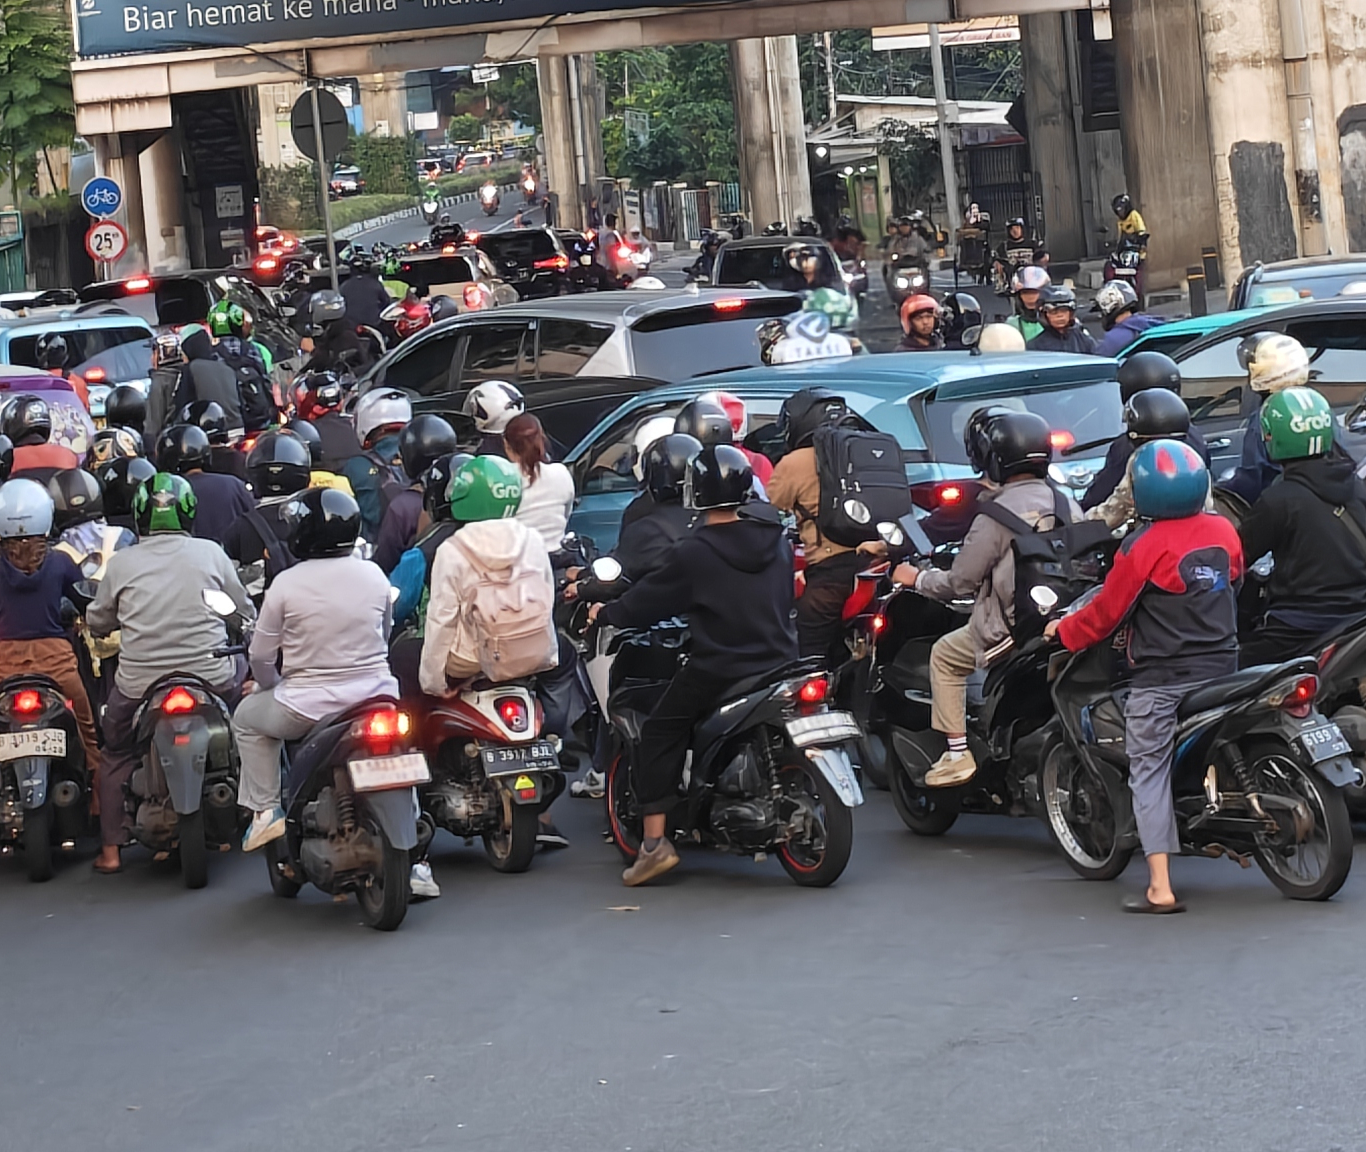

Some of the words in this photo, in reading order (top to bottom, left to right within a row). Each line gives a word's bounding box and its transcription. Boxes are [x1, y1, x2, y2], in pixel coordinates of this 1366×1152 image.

[123, 5, 177, 33] Biar
[186, 0, 275, 28] hemat
[94, 231, 113, 251] 25
[1290, 410, 1331, 433] Grab
